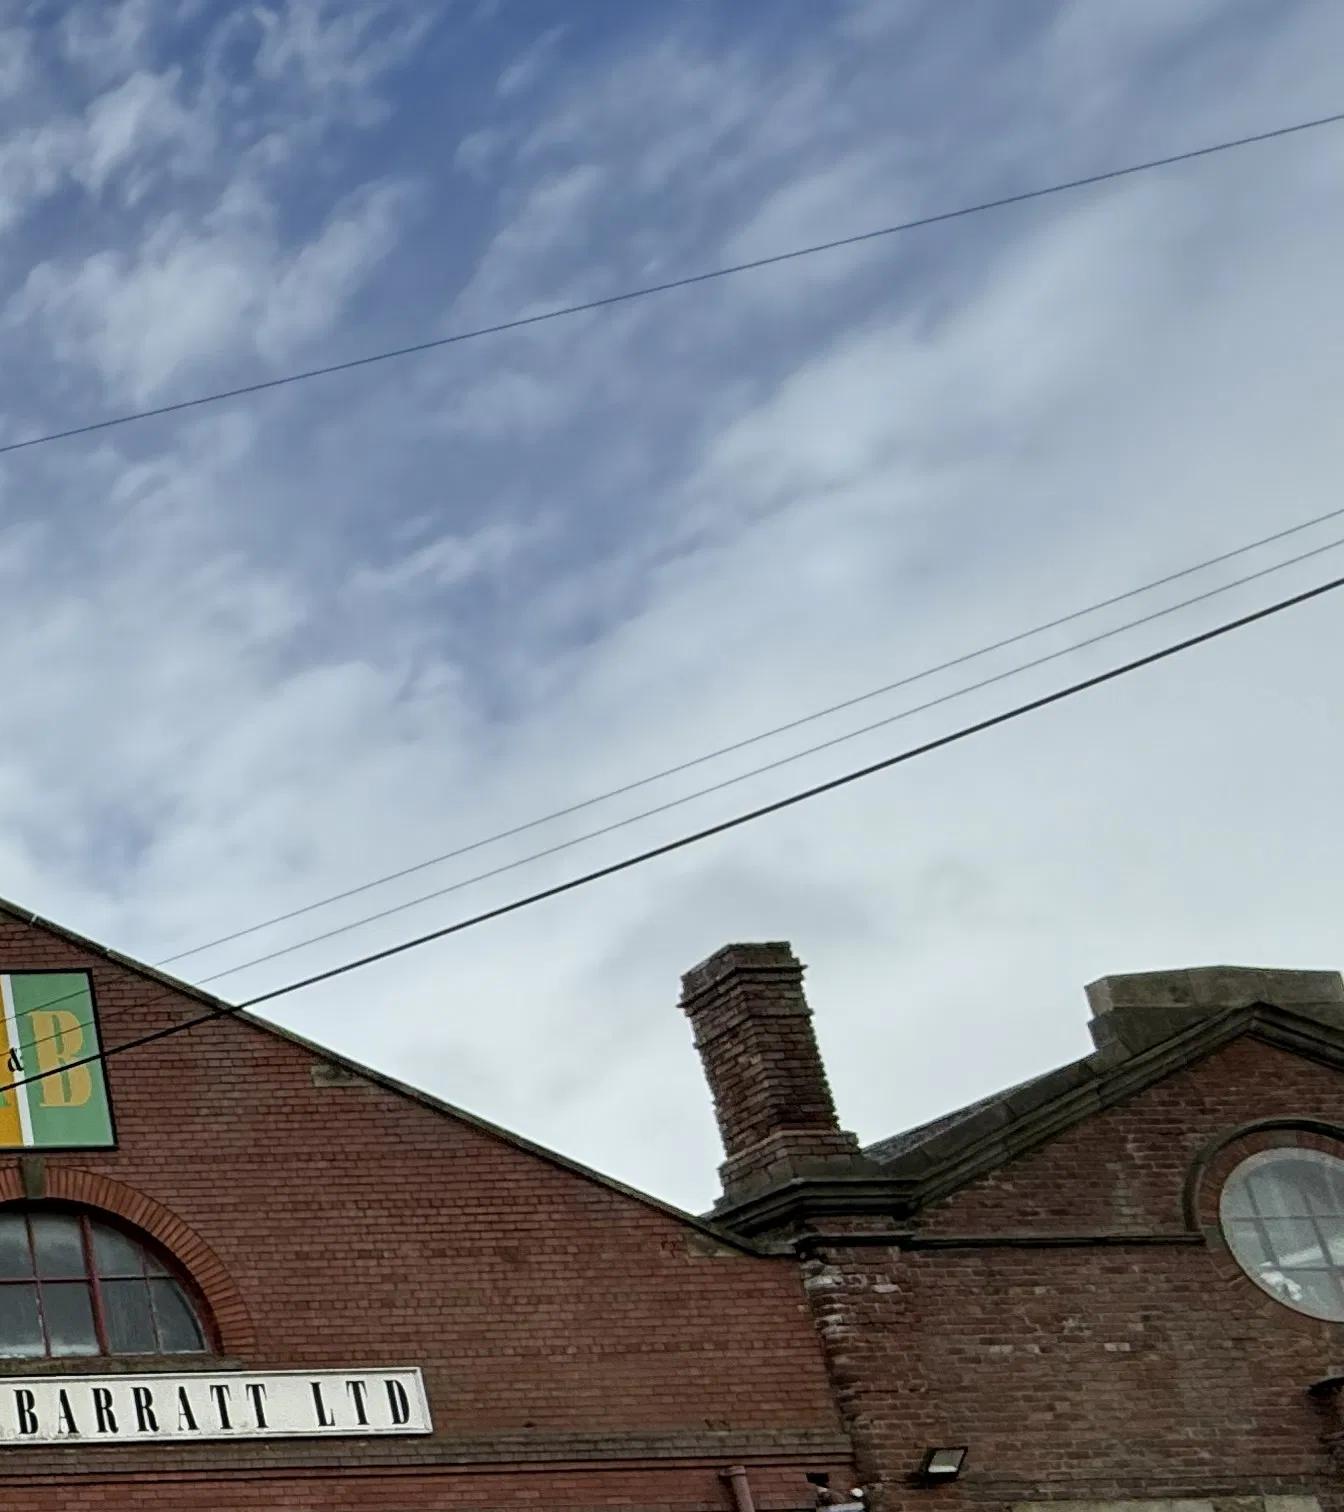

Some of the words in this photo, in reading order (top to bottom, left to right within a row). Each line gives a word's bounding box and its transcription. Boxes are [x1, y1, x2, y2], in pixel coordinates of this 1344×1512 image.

[7, 1047, 25, 1073] &
[31, 1010, 92, 1108] B
[13, 1383, 268, 1435] BARRATT
[309, 1378, 411, 1428] LTD
